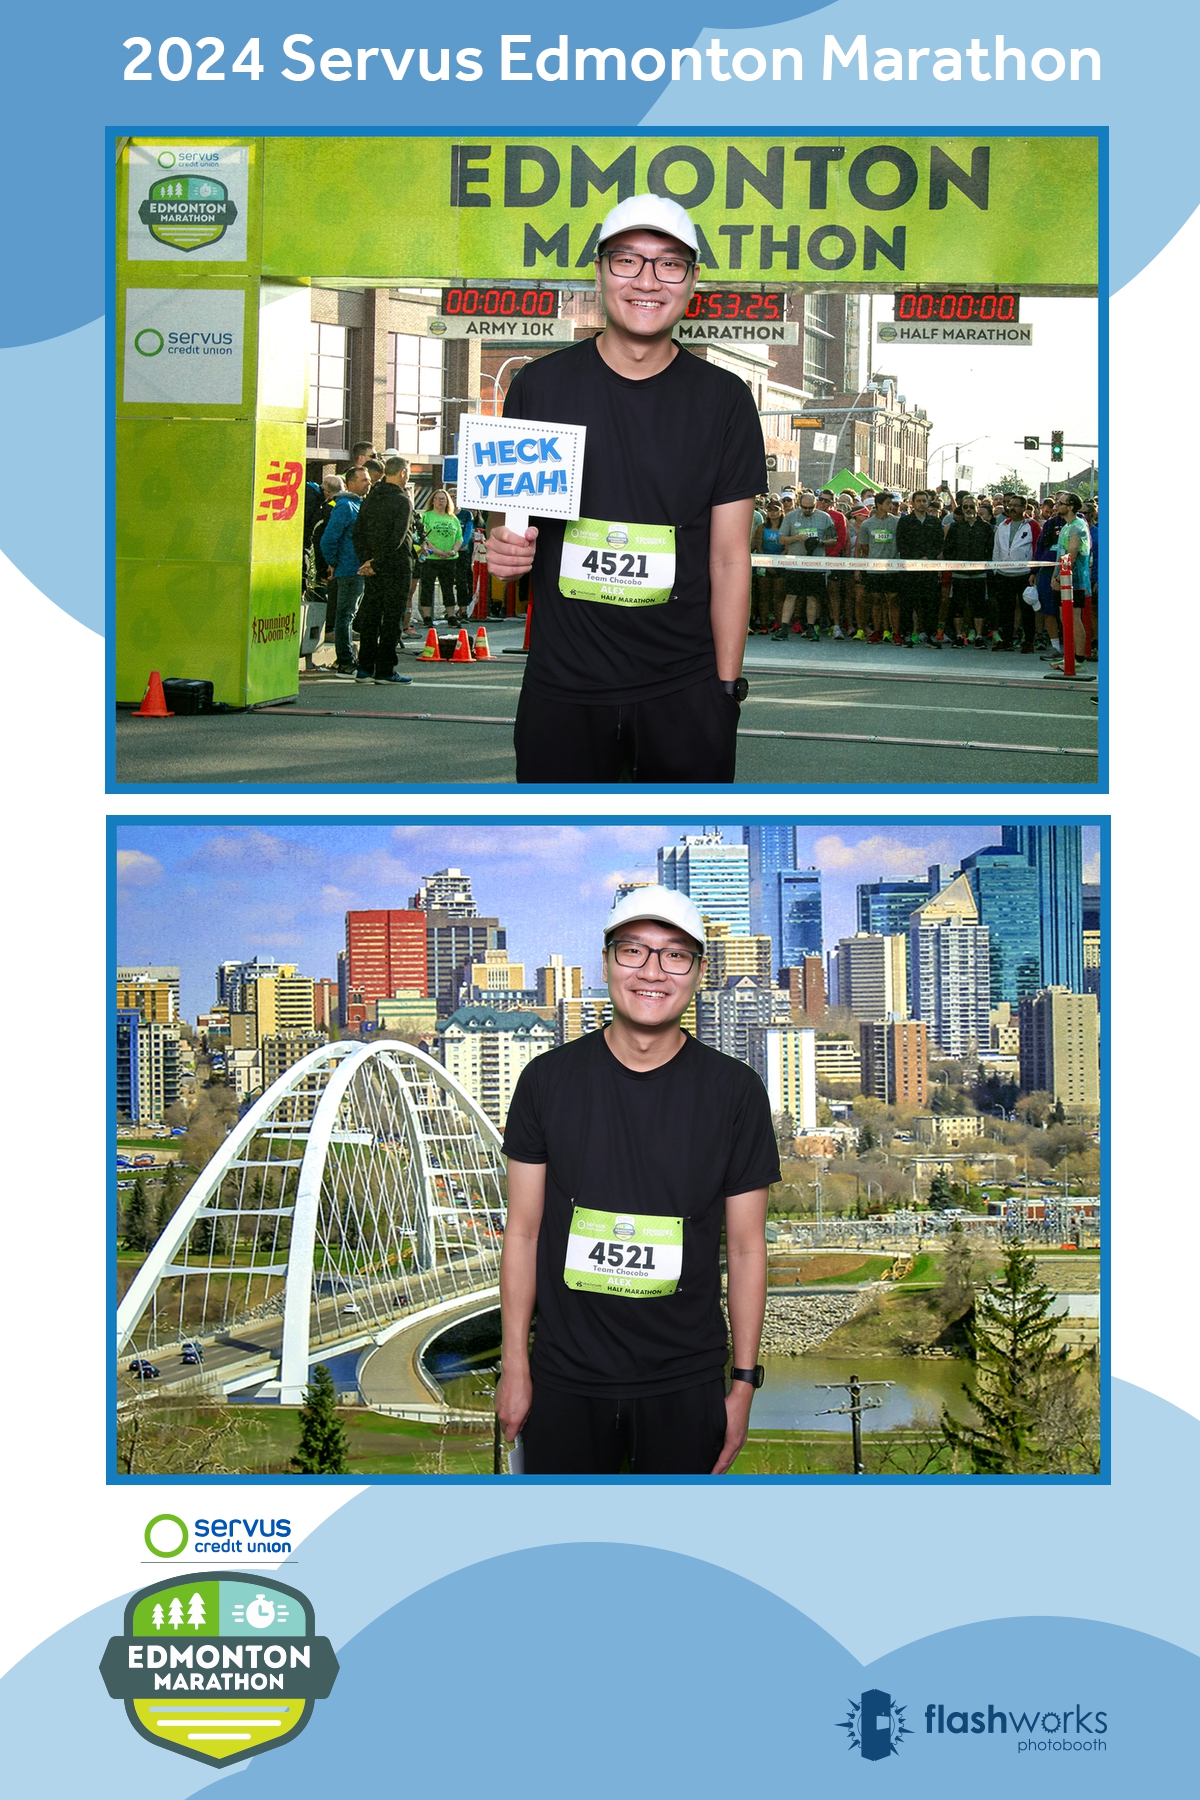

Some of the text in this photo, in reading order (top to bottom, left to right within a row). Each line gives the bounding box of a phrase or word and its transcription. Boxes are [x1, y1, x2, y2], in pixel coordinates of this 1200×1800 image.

[178, 153, 219, 161] servus
[450, 145, 990, 211] EDMONTON
[149, 203, 227, 213] EDMONTON
[160, 214, 215, 222] MARATHON
[466, 321, 554, 336] ARMY 10K
[679, 325, 785, 340] MARATHON
[900, 328, 939, 340] HALF
[943, 328, 1031, 341] MARATHON
[168, 332, 233, 345] servus
[168, 345, 233, 355] credit union
[472, 437, 562, 467] HECK
[474, 469, 568, 499] YEAH!
[582, 550, 649, 578] 4521
[587, 573, 643, 586] Team Chocobo
[601, 586, 625, 596] ALEX
[601, 594, 617, 602] HALF
[257, 613, 290, 637] Running
[588, 1241, 655, 1270] 4521
[593, 1265, 649, 1277] Team Chocobo
[607, 1277, 632, 1287] ALEX
